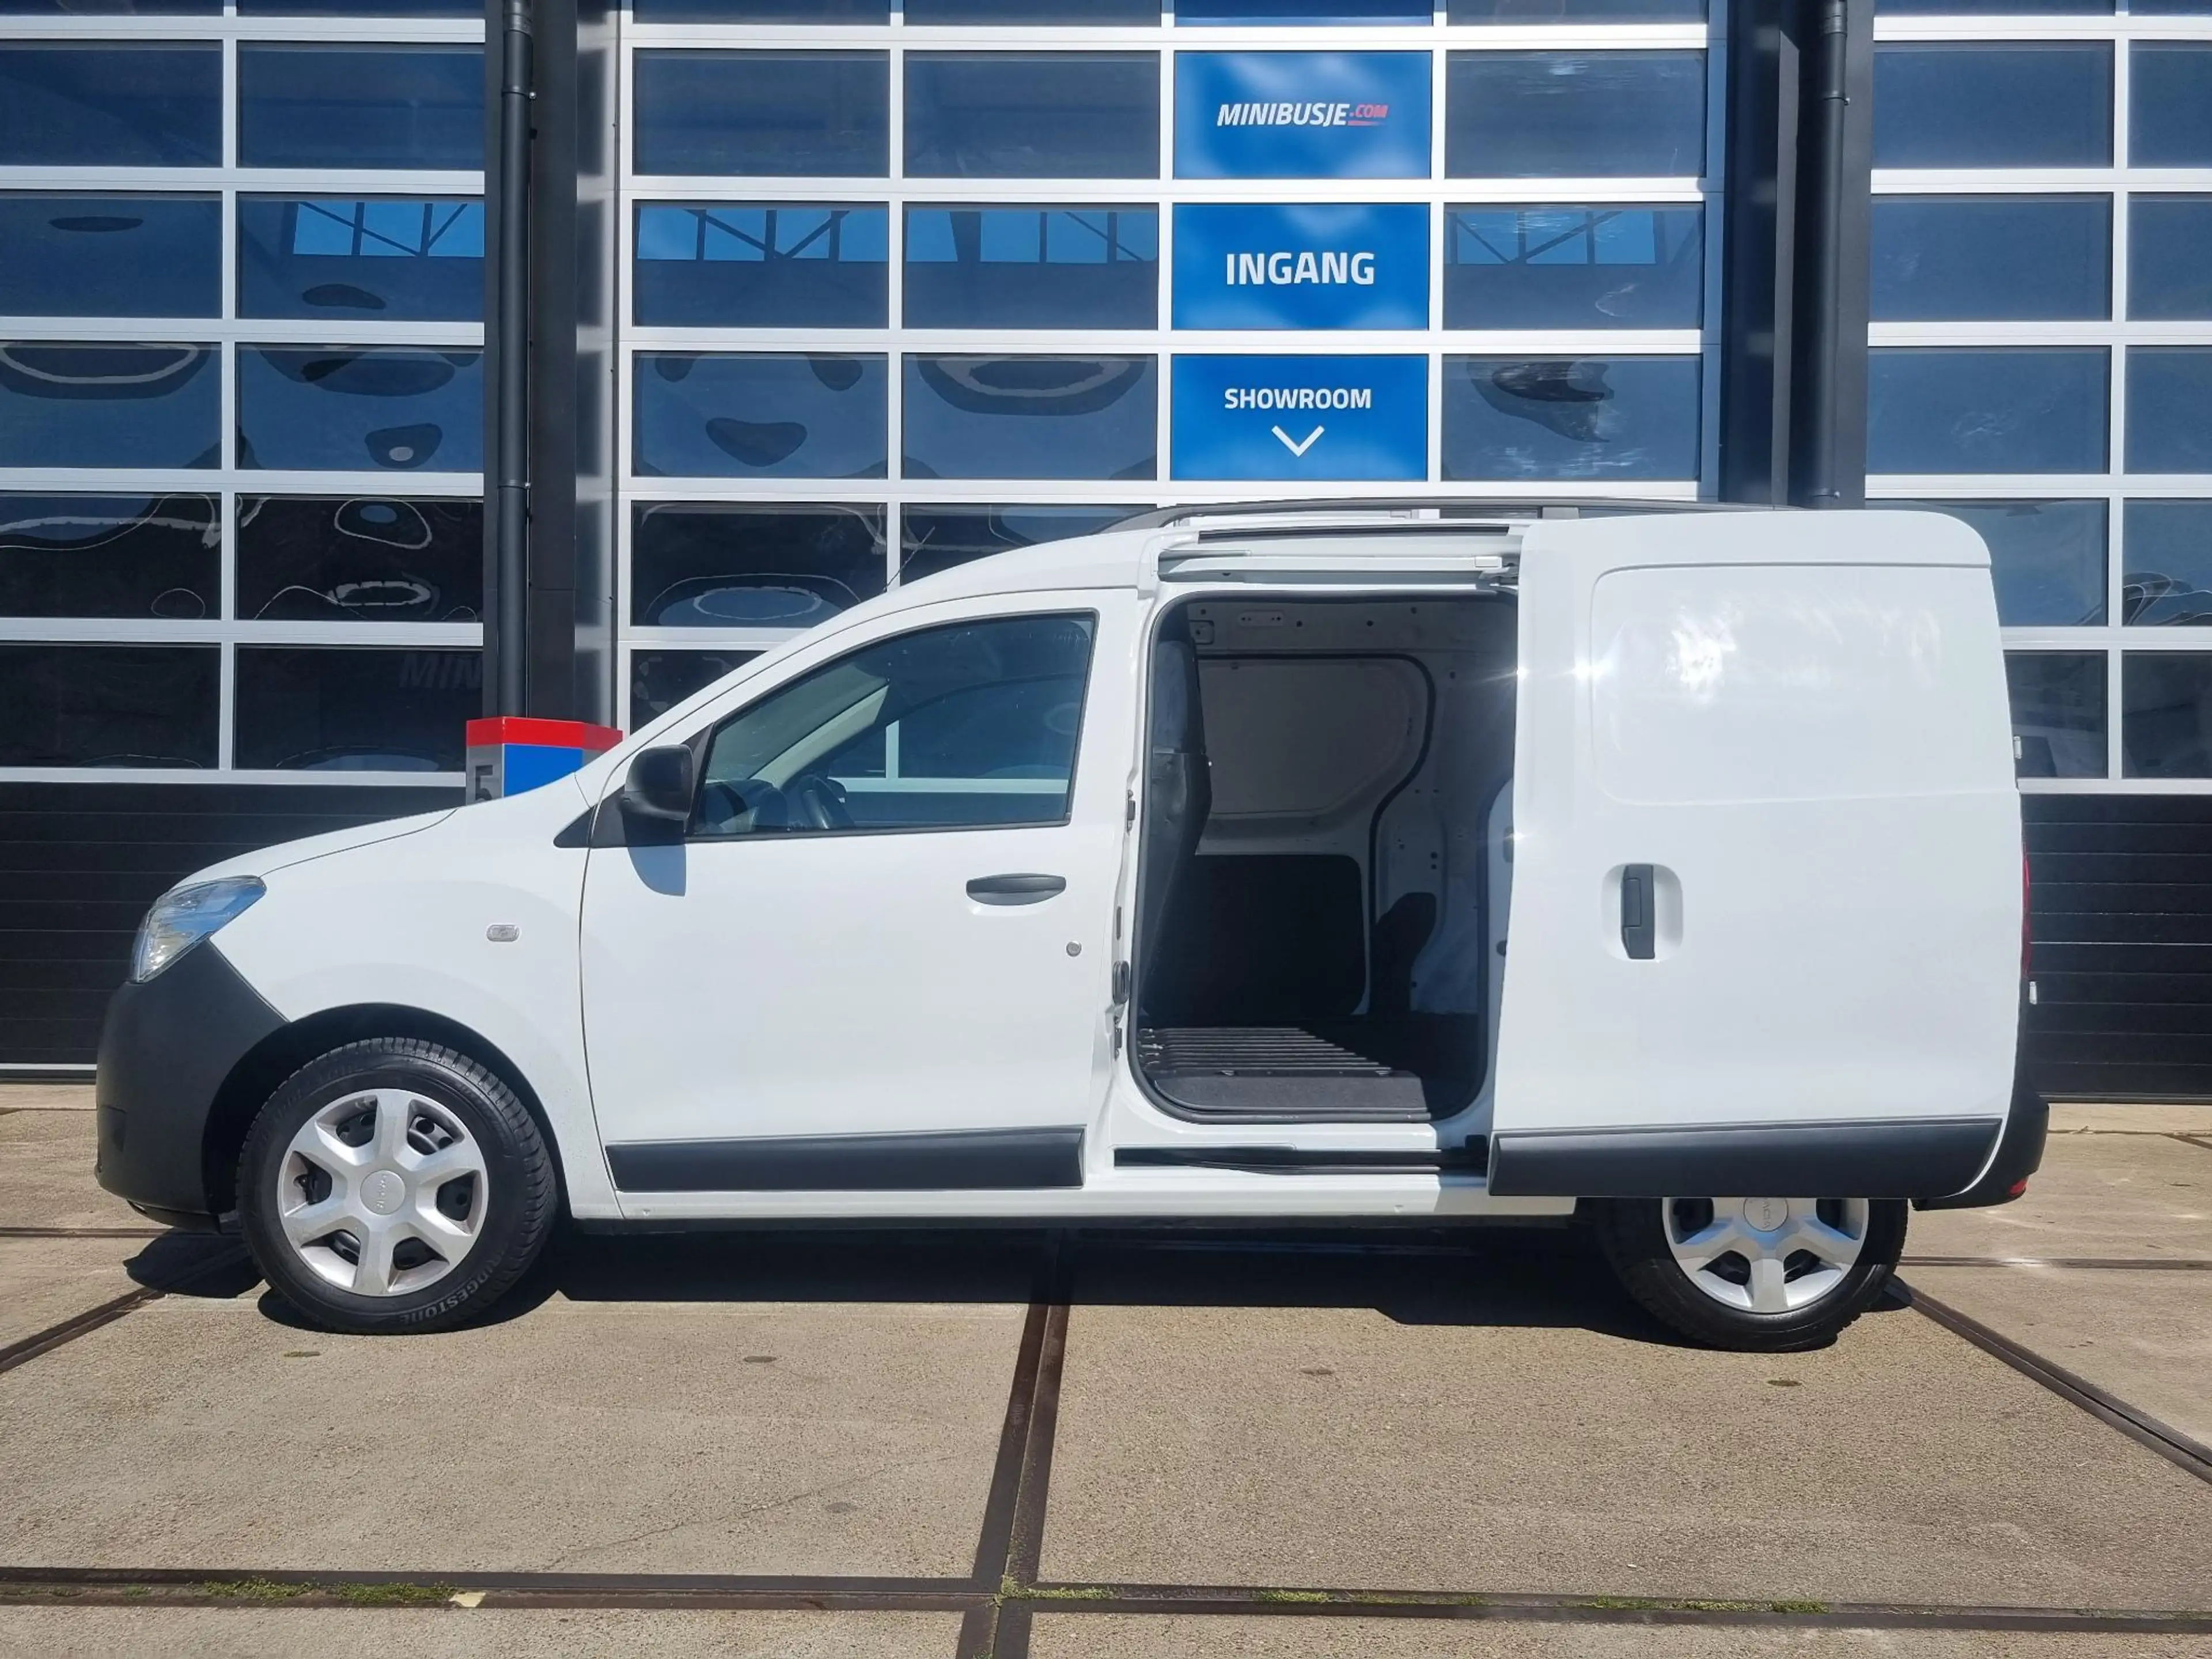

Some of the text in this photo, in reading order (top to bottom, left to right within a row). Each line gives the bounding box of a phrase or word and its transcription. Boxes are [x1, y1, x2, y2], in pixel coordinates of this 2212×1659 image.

[1217, 103, 1389, 127] MINIBUSJE.COM
[1226, 252, 1375, 286] INGANG
[1224, 388, 1372, 410] SHOWROOM
